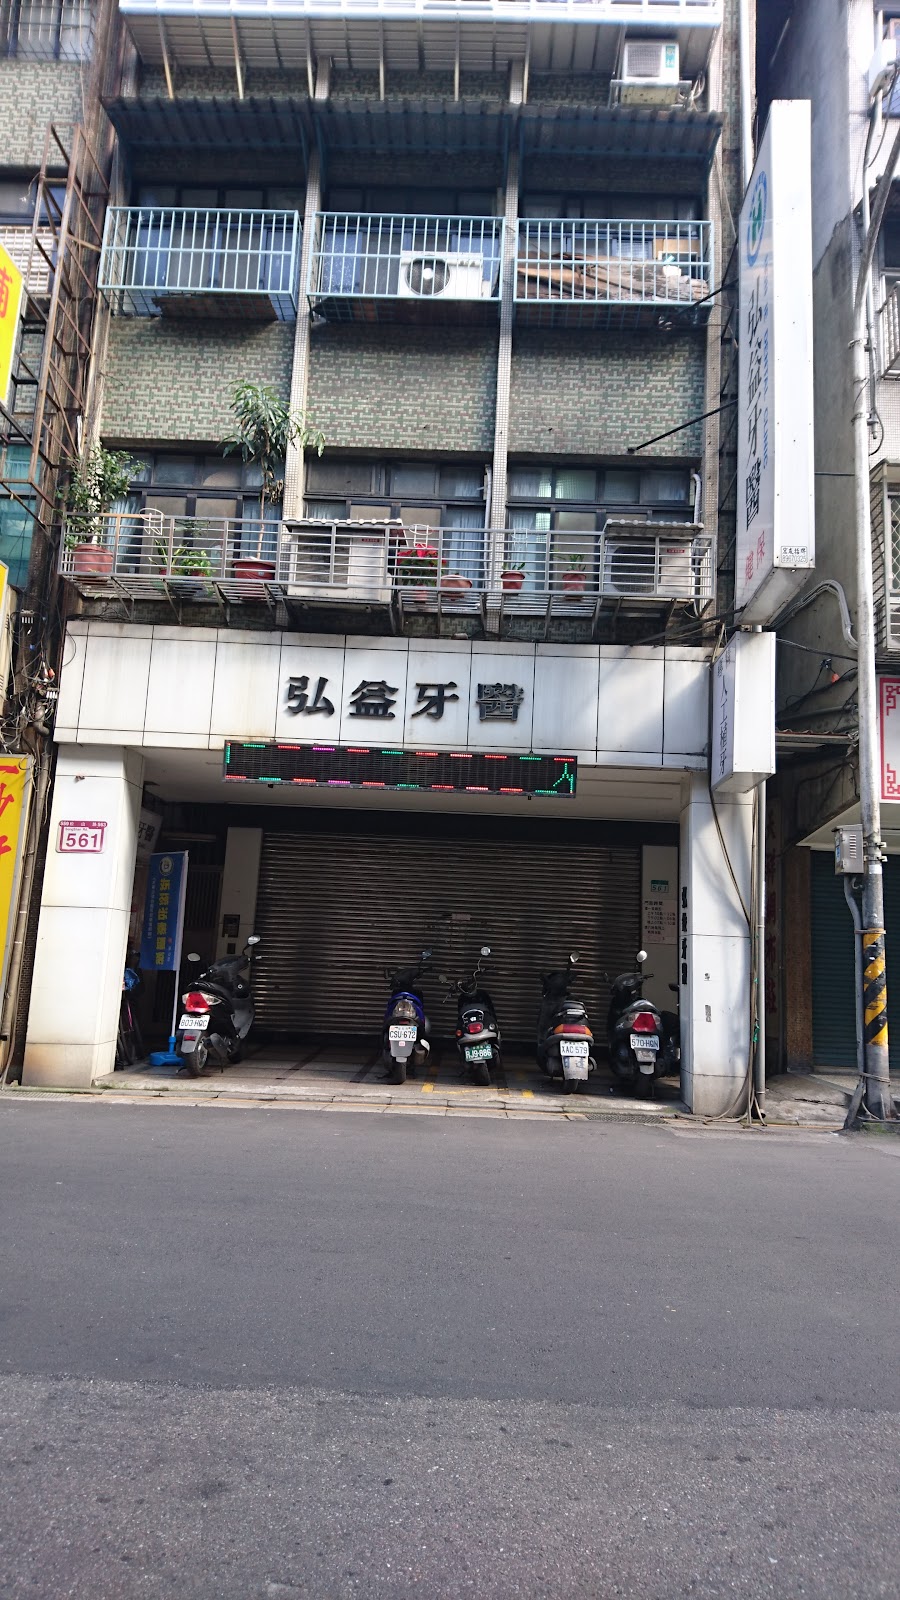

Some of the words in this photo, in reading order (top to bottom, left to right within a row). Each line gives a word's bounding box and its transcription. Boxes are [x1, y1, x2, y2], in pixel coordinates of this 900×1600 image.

[746, 275, 762, 531] 弘益牙醫
[286, 675, 525, 723] 弘益牙醫
[66, 833, 98, 848] 561
[389, 1031, 416, 1039] CSU-672
